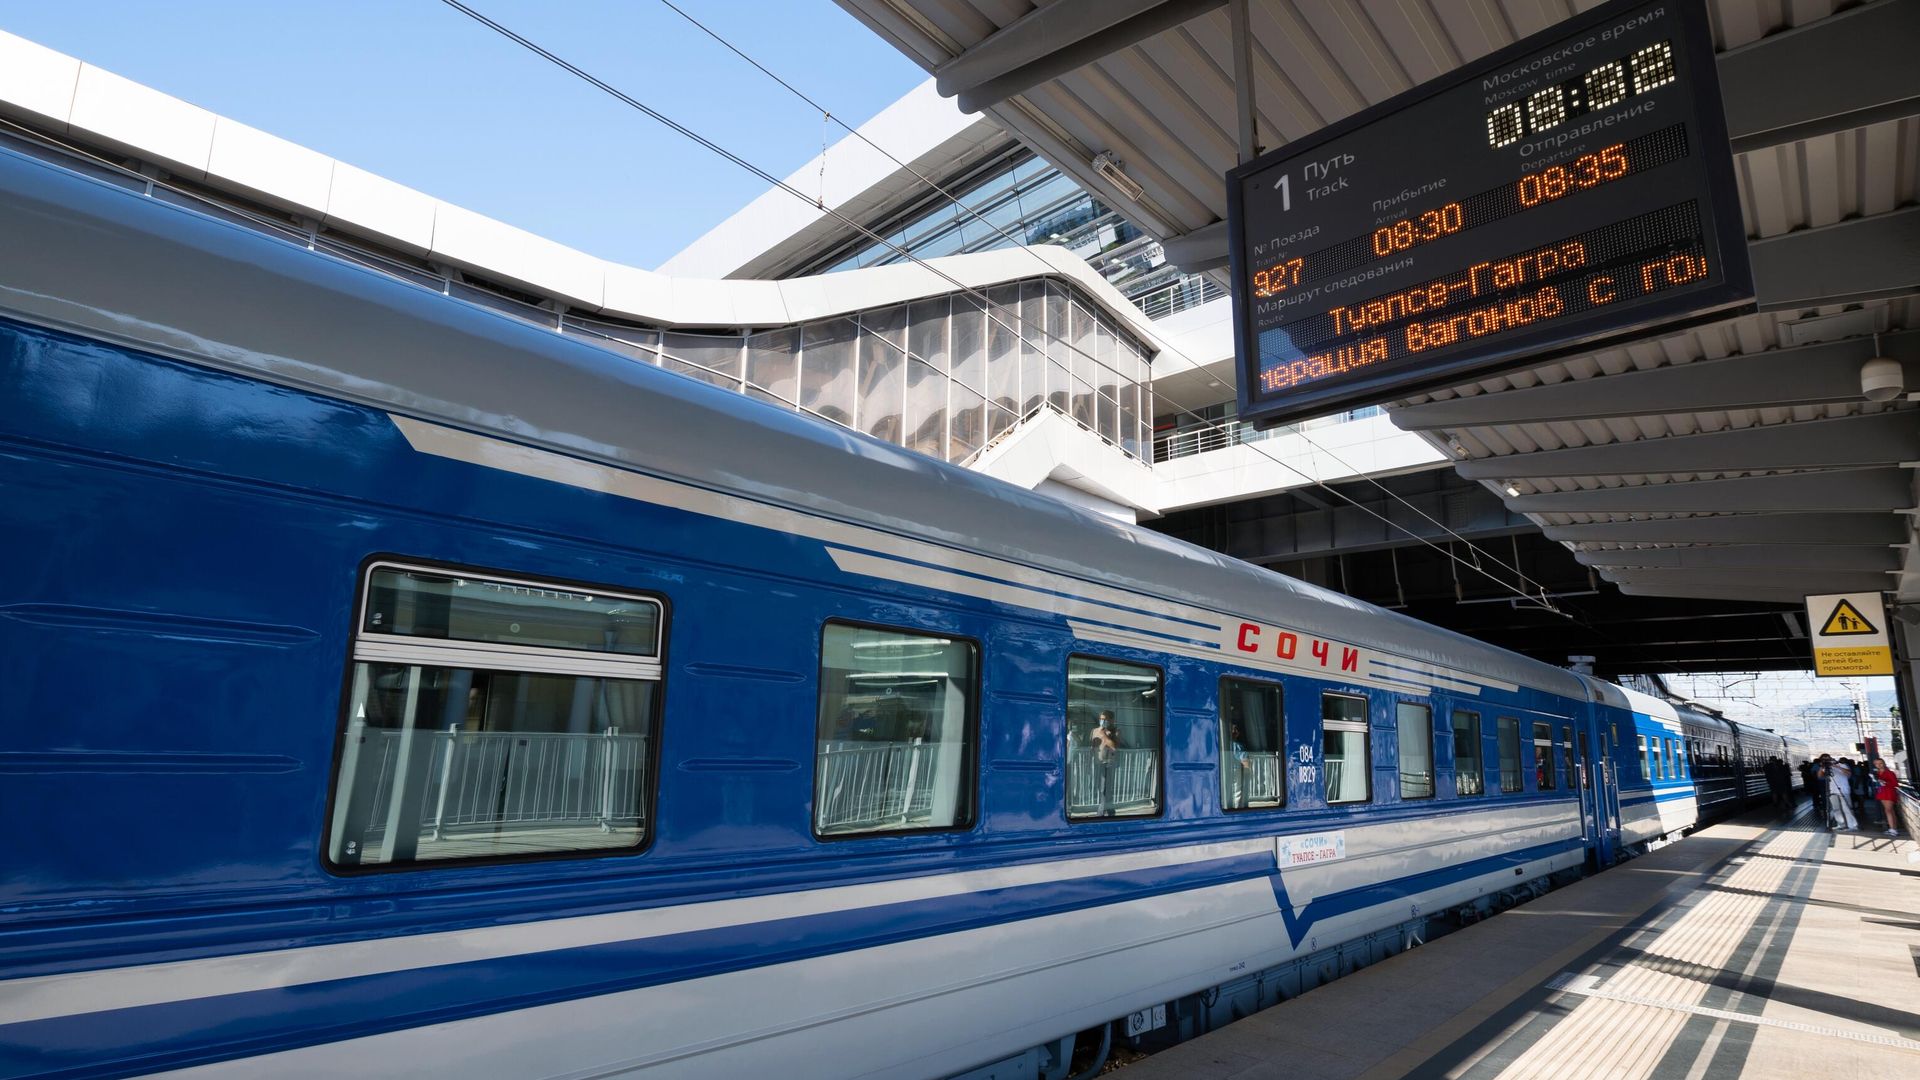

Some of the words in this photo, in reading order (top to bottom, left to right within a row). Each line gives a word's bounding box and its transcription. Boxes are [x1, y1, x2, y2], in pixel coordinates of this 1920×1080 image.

[1482, 36, 1596, 90] Московское
[1600, 7, 1665, 41] время
[1484, 78, 1538, 104] Moscow
[1545, 62, 1576, 80] time
[1519, 100, 1656, 157] Отправление
[1303, 153, 1355, 181] Путь
[1521, 144, 1586, 172] Departure
[1306, 176, 1349, 201] Track
[1519, 143, 1627, 207] 08:35
[1273, 174, 1291, 212] 1
[1372, 177, 1448, 213] Прибытие
[1373, 202, 1463, 257] 08:30
[1375, 208, 1408, 226] Arrival
[1271, 224, 1320, 251] Поезда
[1256, 255, 1276, 267] Train
[1254, 257, 1305, 298] 927
[1257, 287, 1321, 315] Маршрут
[1323, 256, 1414, 294] следования
[1258, 313, 1285, 327] Route
[1237, 622, 1358, 672] СОЧИ
[1822, 657, 1846, 665] детей
[1823, 664, 1872, 672] присмотра!
[1299, 745, 1314, 763] 084
[1292, 851, 1315, 863] ТУАПСЕ
[1320, 849, 1336, 859] ГАГРА
